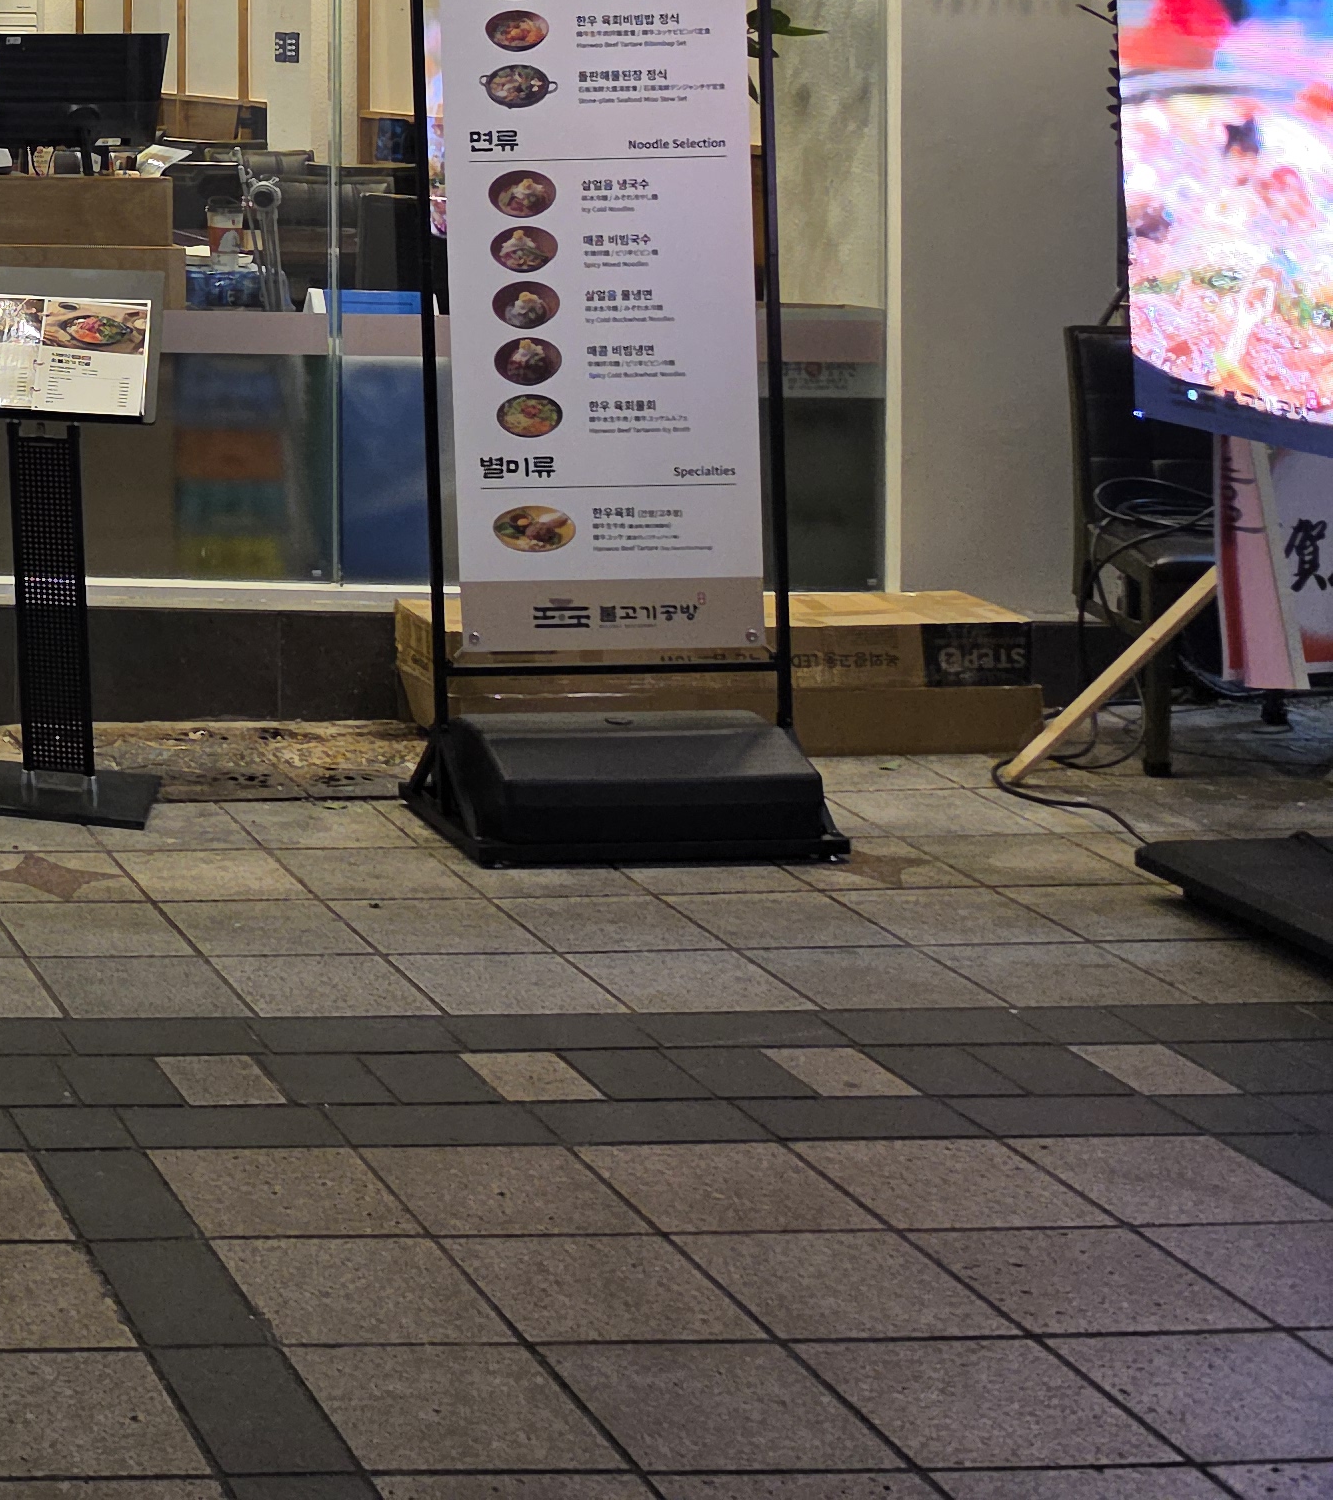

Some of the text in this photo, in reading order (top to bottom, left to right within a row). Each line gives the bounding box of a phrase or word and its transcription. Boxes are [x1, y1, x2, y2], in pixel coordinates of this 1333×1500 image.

[576, 15, 598, 27] 한우
[658, 13, 680, 25] 정식
[646, 69, 668, 81] 정식
[469, 130, 519, 153] 면류
[629, 137, 726, 150] Noodle Selection
[479, 456, 556, 480] 별미류
[673, 465, 736, 478] Specialties
[599, 603, 698, 622] 불고기공방
